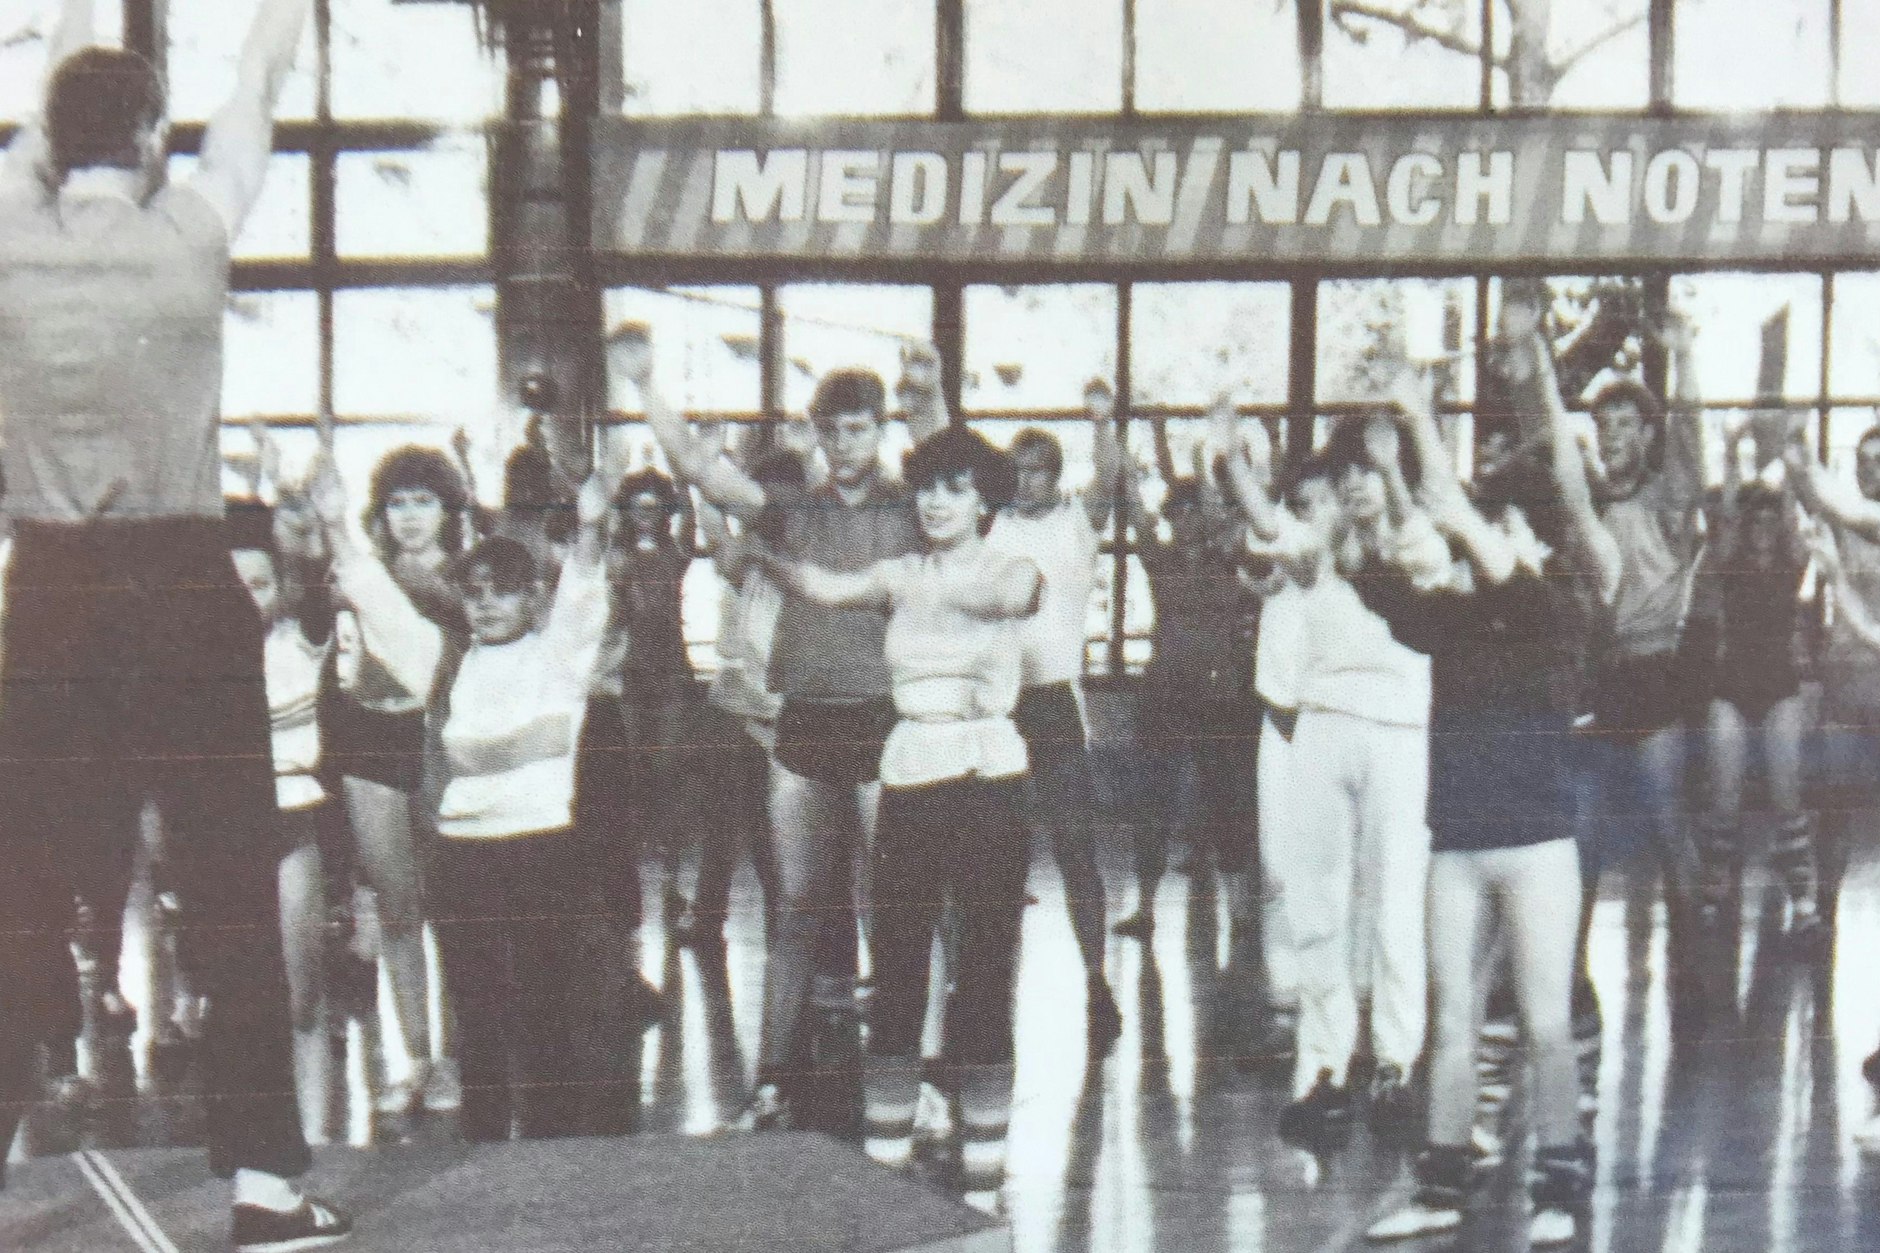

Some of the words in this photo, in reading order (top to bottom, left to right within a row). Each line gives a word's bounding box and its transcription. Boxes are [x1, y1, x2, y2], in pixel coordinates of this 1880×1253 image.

[712, 149, 1178, 225] MEDIZIN
[1226, 149, 1512, 225] NACH
[1562, 147, 1880, 224] NOTEN
